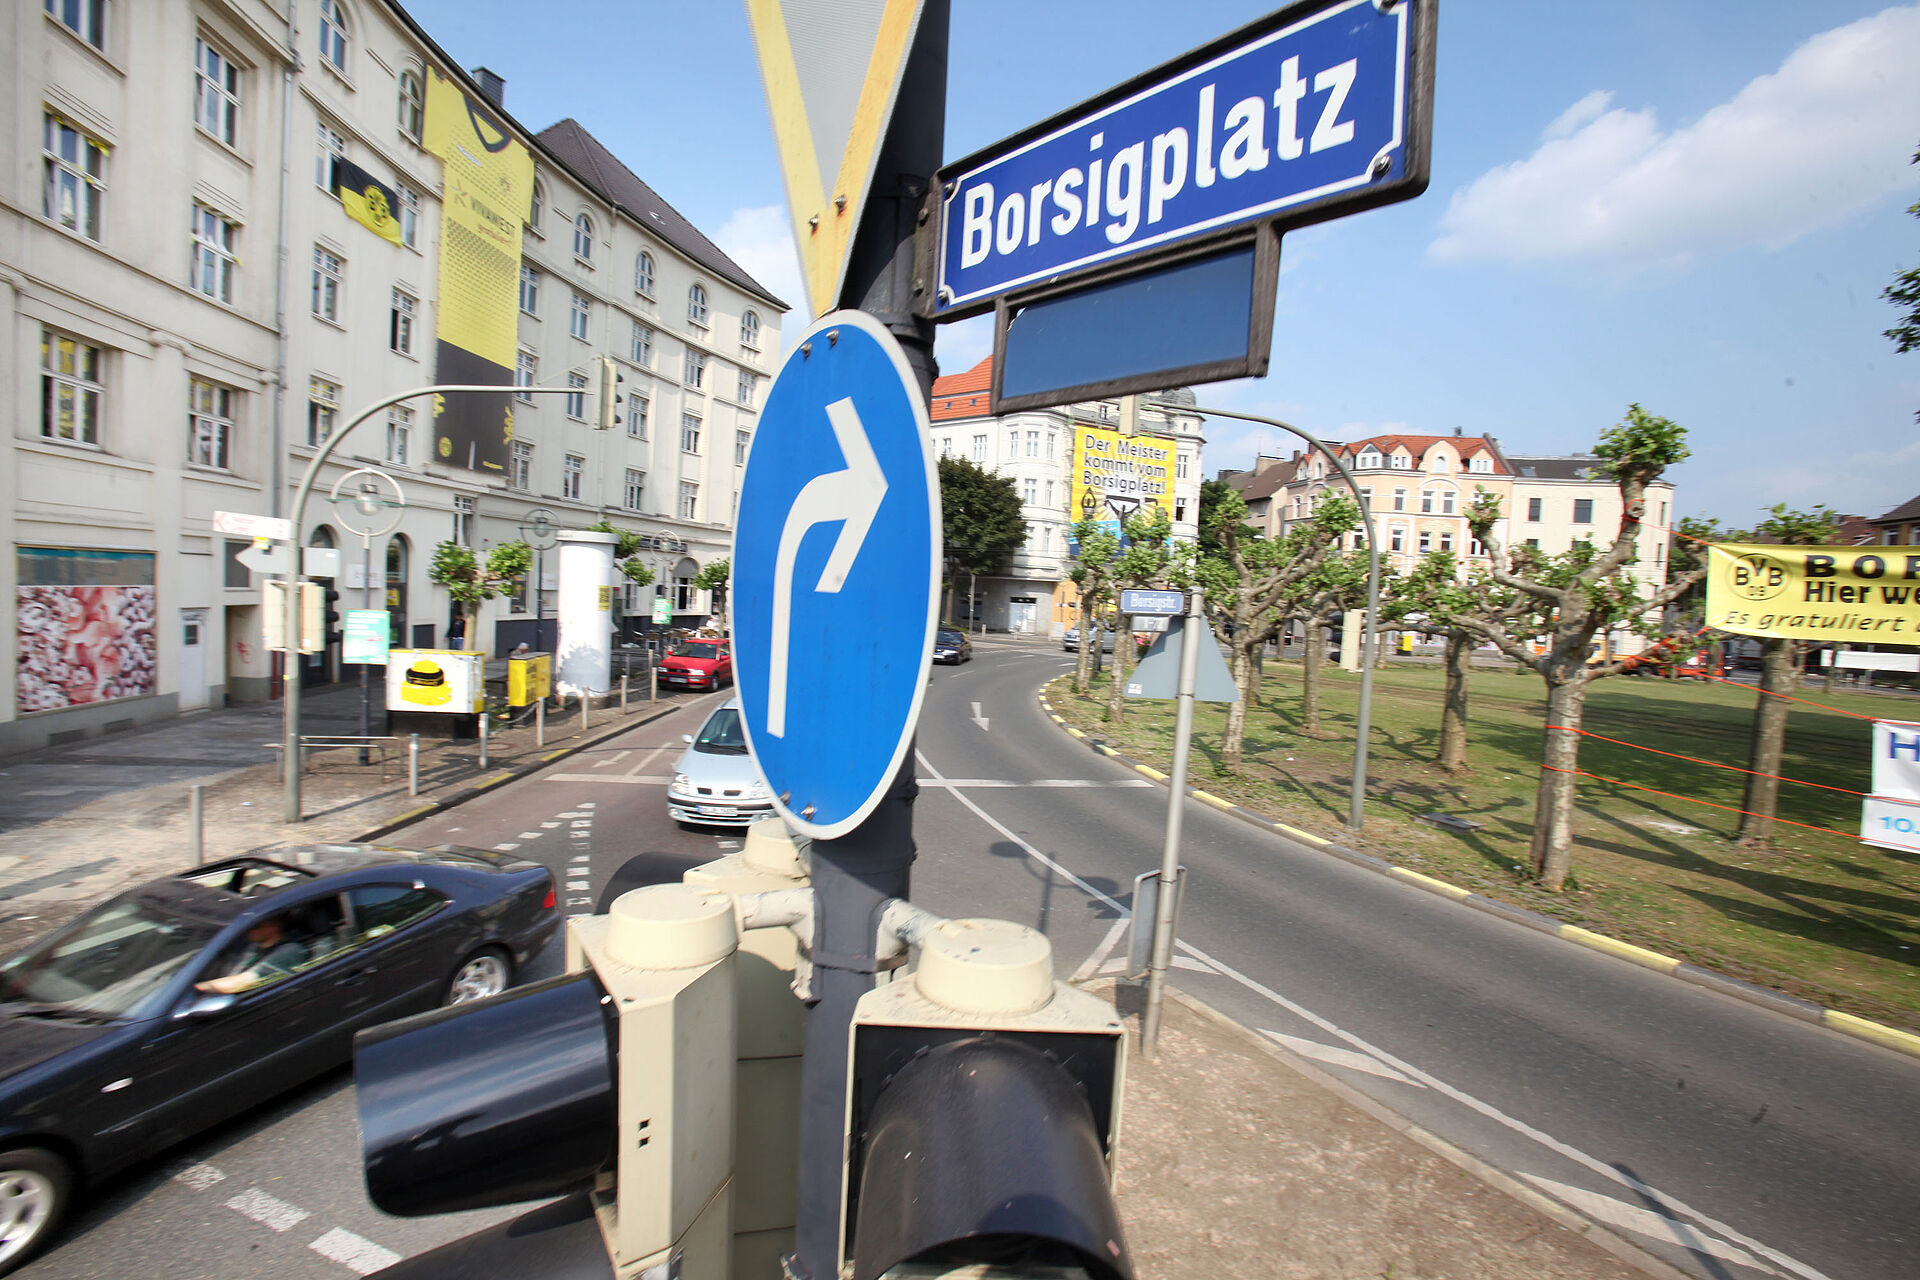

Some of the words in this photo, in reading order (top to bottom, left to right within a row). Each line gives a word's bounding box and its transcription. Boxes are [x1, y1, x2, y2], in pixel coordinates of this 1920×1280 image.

[960, 54, 1357, 270] Borsigplatz
[1085, 434, 1111, 452] Der
[1117, 439, 1168, 460] Meister
[1083, 452, 1135, 473] kommt
[1138, 463, 1167, 478] vom
[1083, 470, 1166, 494] Borsigplatz!
[1734, 558, 1785, 587] BVB
[1803, 581, 1870, 603] Hier
[1724, 610, 1750, 625] Es
[1757, 612, 1907, 632] gratuliert
